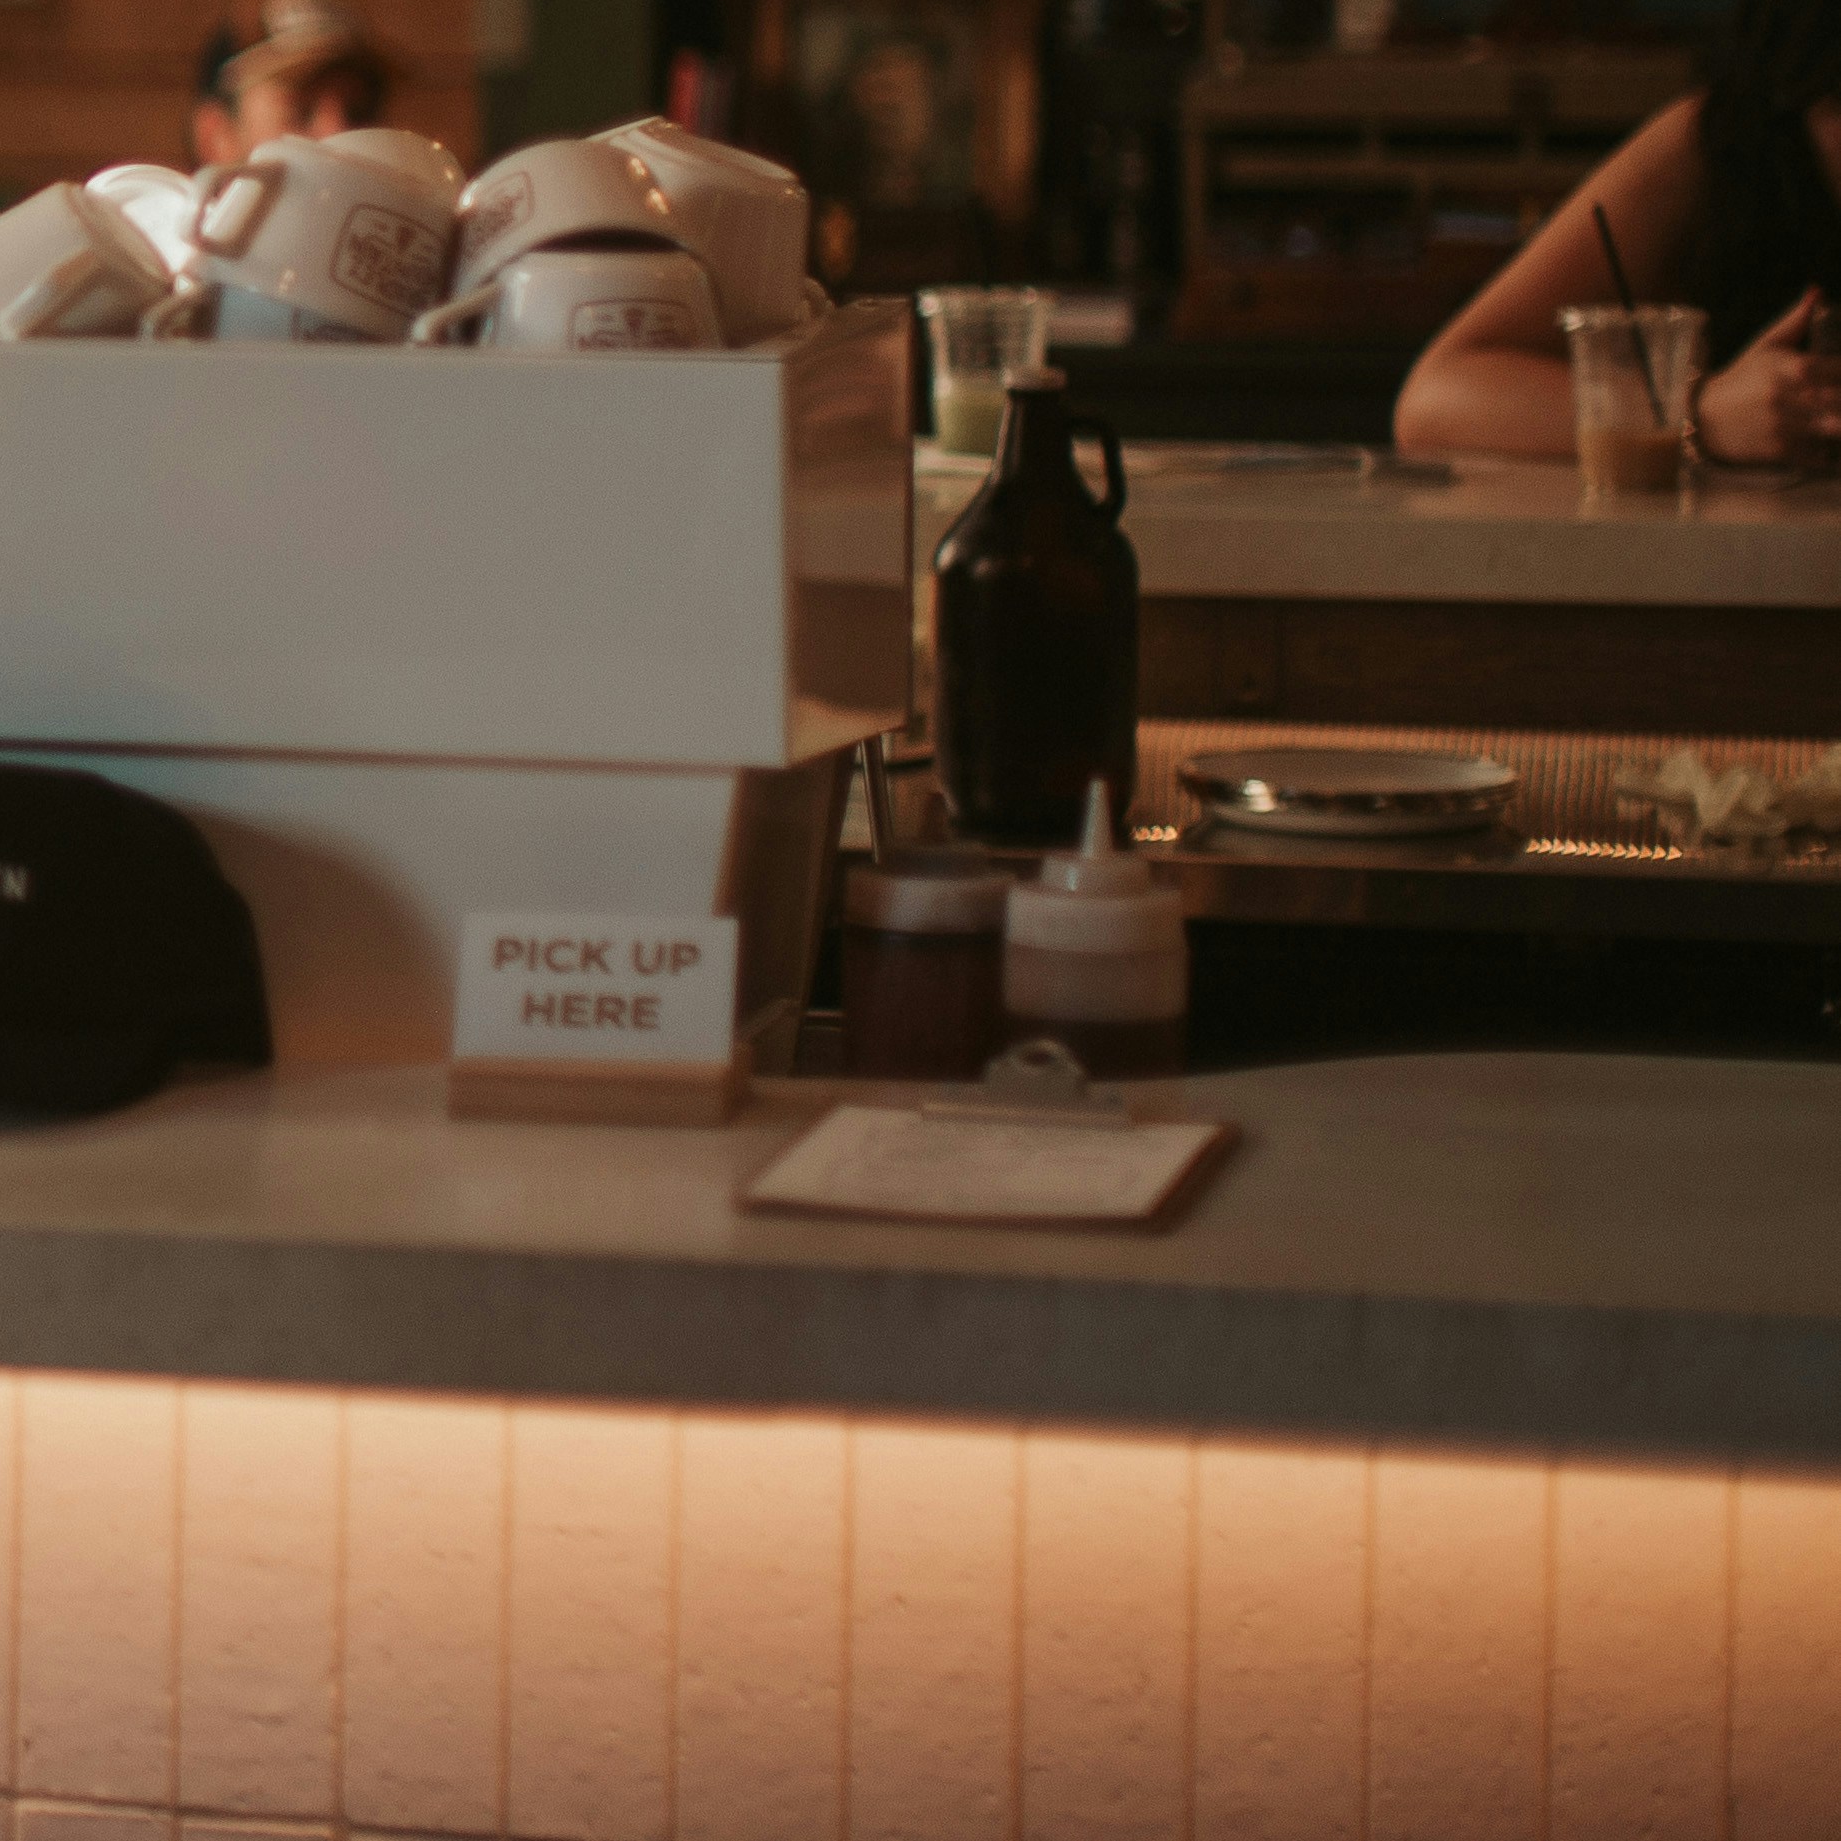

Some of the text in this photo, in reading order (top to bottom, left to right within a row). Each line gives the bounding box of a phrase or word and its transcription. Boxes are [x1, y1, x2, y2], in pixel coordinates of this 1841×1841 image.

[492, 934, 702, 978] PICK UP
[521, 991, 662, 1031] HERE
